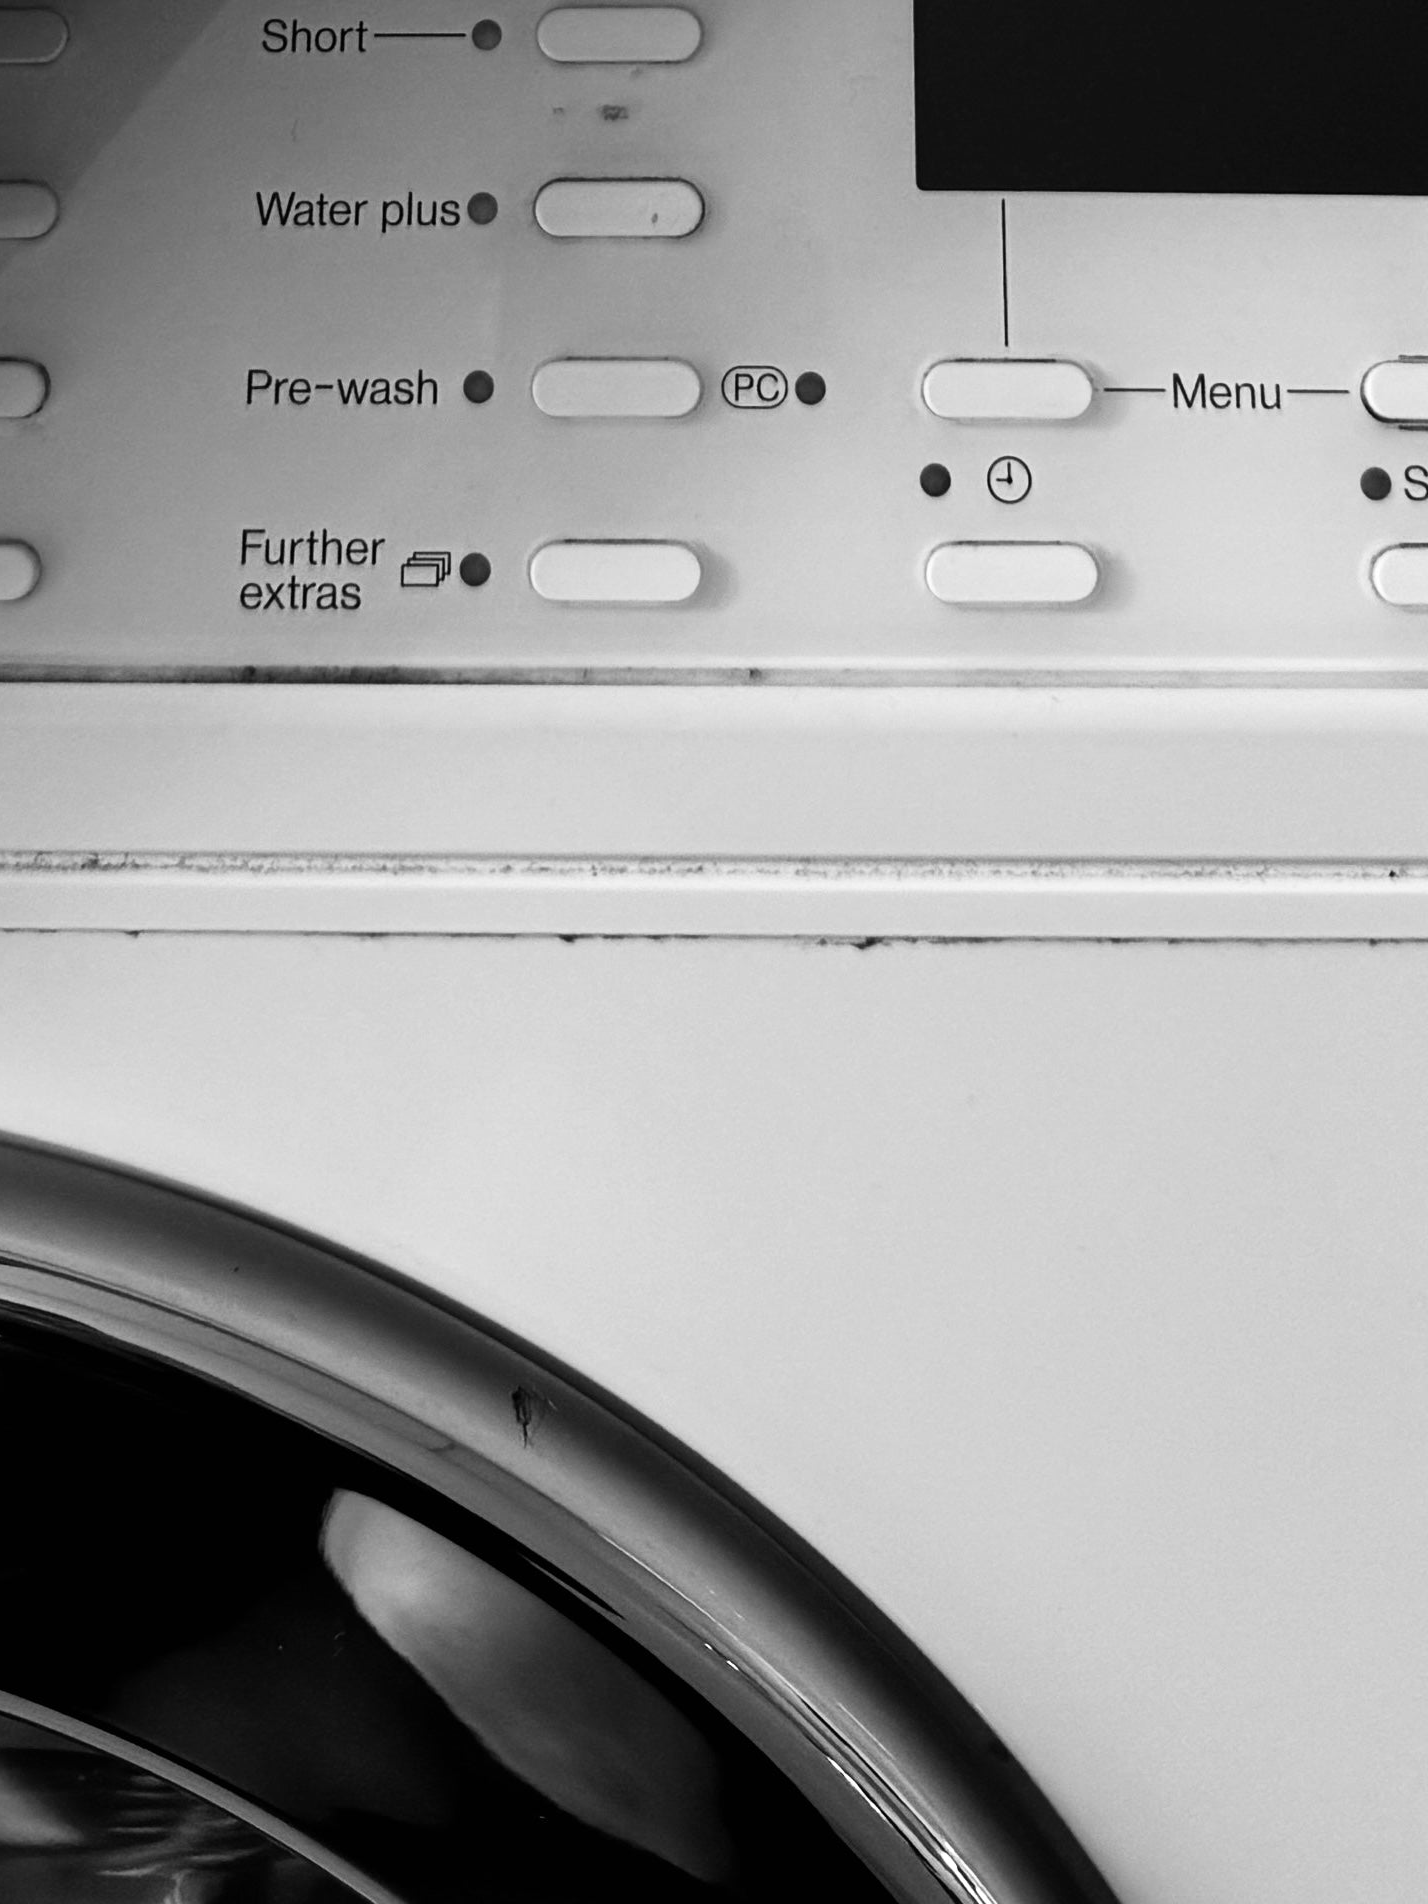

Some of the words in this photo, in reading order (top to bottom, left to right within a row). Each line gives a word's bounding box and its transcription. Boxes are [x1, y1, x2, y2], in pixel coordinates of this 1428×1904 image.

[261, 18, 368, 54] Short
[255, 191, 369, 227] Water
[381, 191, 461, 234] plus
[246, 369, 438, 406] Pre-wash
[733, 371, 783, 403] PC
[1172, 372, 1281, 410] Menu
[240, 528, 386, 566] Further
[239, 575, 362, 611] extras
